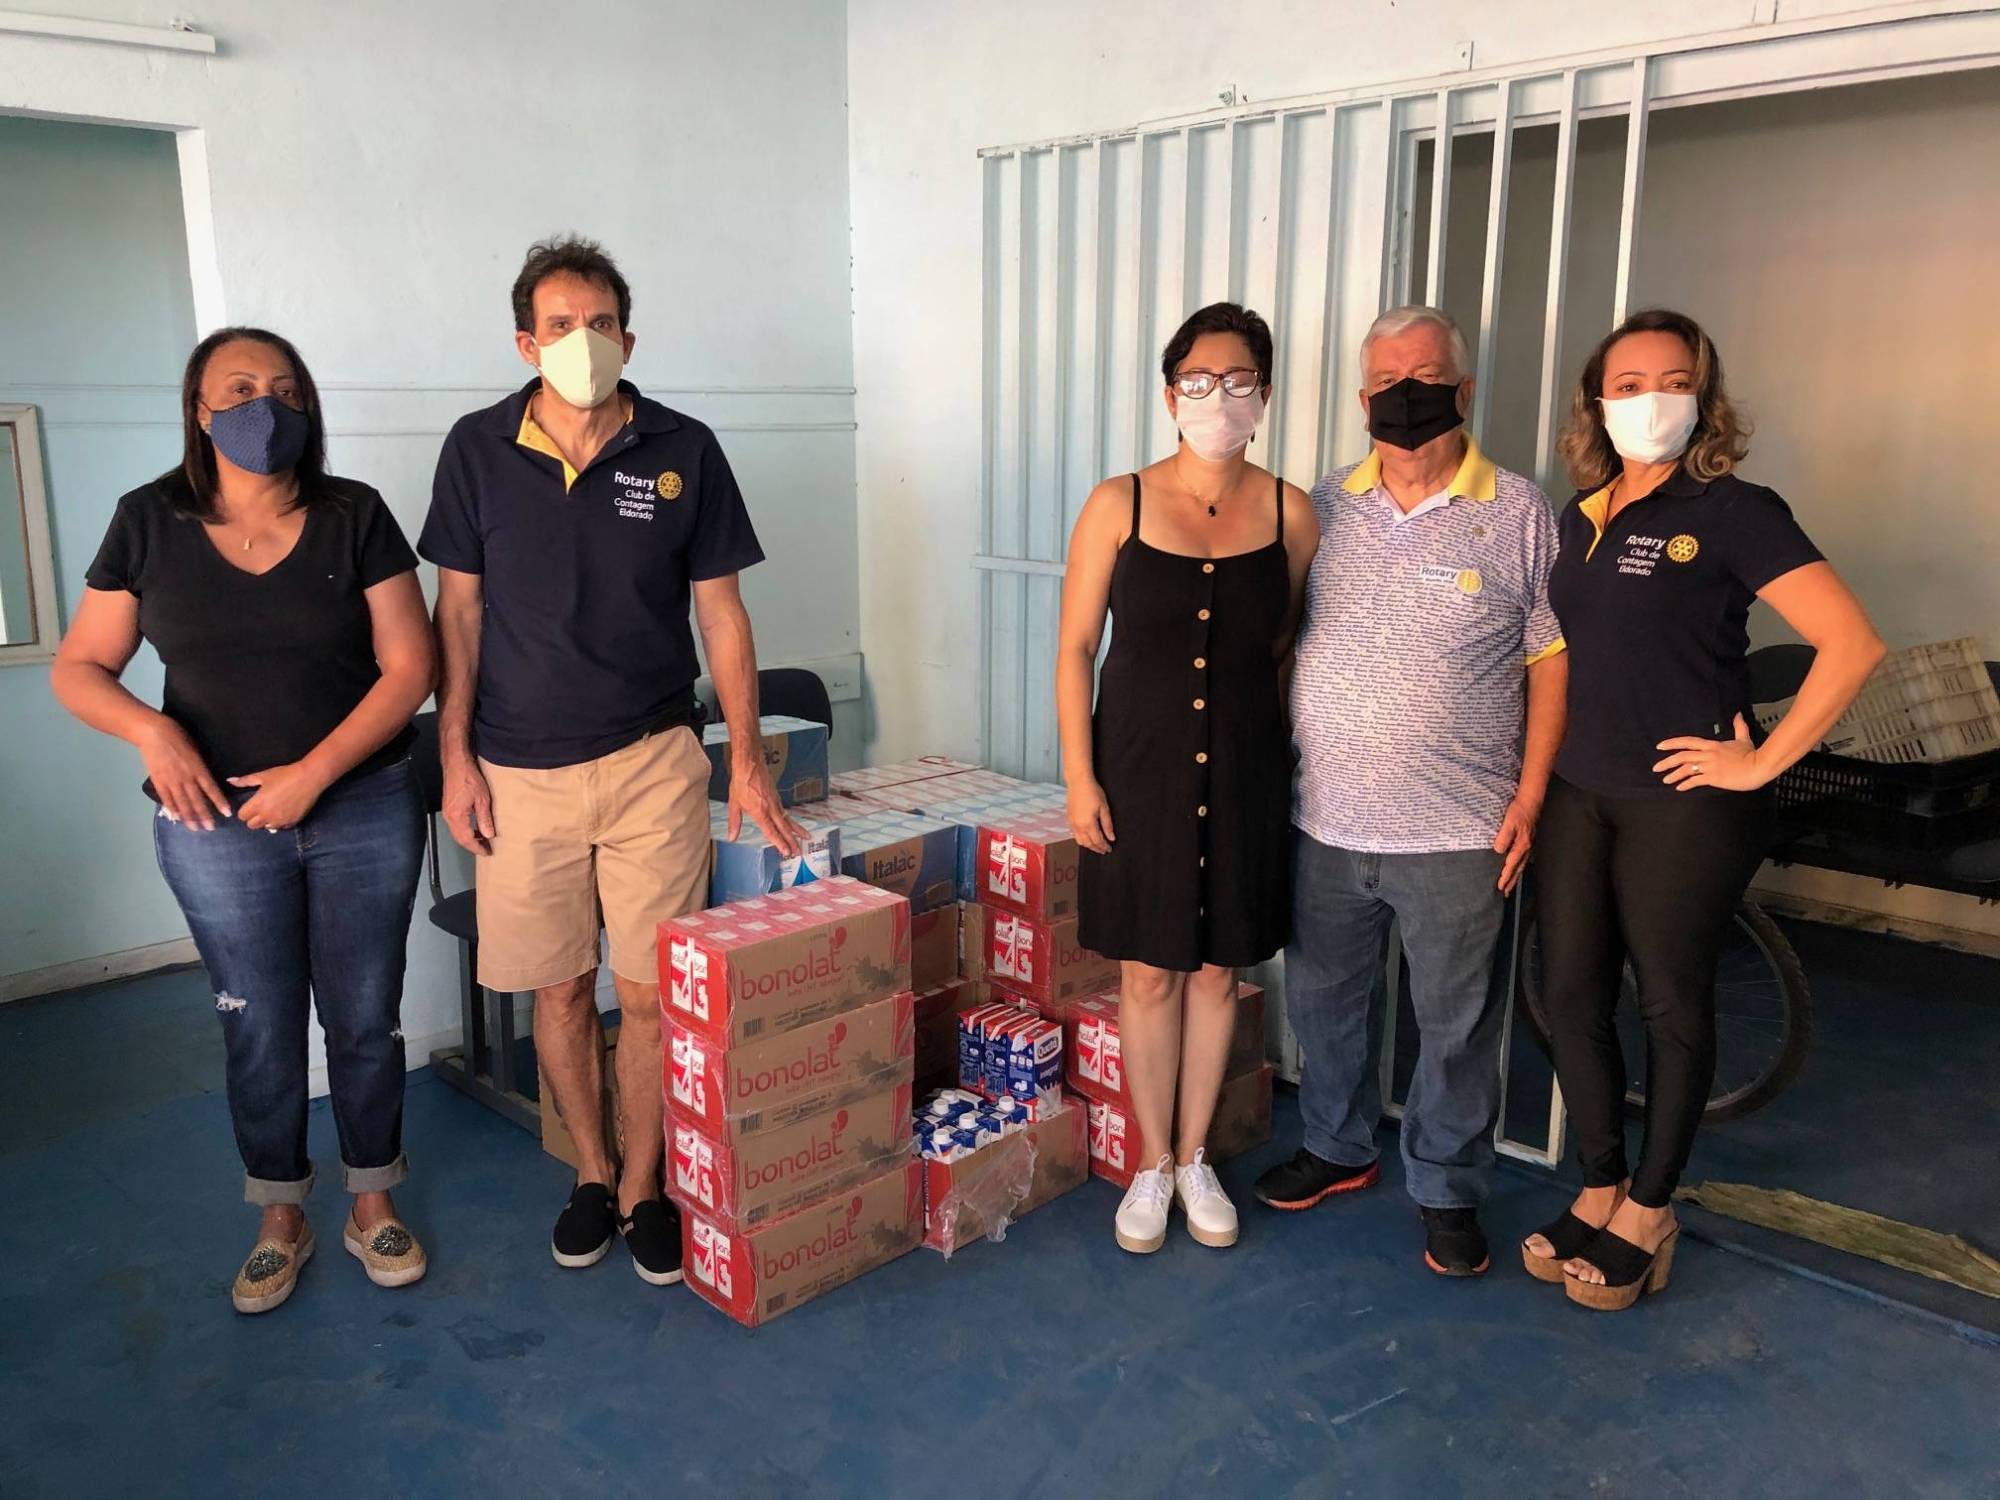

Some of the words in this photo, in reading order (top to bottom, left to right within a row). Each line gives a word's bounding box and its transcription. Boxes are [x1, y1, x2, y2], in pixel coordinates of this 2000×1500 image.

[613, 471, 656, 490] Rotary
[625, 489, 643, 500] Club
[644, 492, 656, 501] de
[613, 498, 655, 511] Contagem
[619, 507, 654, 521] Eldorado
[1625, 534, 1667, 550] Rotary
[1630, 548, 1648, 558] Club
[1648, 551, 1661, 559] de
[1616, 556, 1656, 567] Contagem
[1421, 566, 1457, 580] Rotary
[1618, 565, 1652, 576] Eldorado
[739, 944, 841, 1001] bonolat
[736, 1040, 841, 1099] bonolat
[744, 1130, 843, 1190] bonolat
[762, 1217, 858, 1280] bonolat
